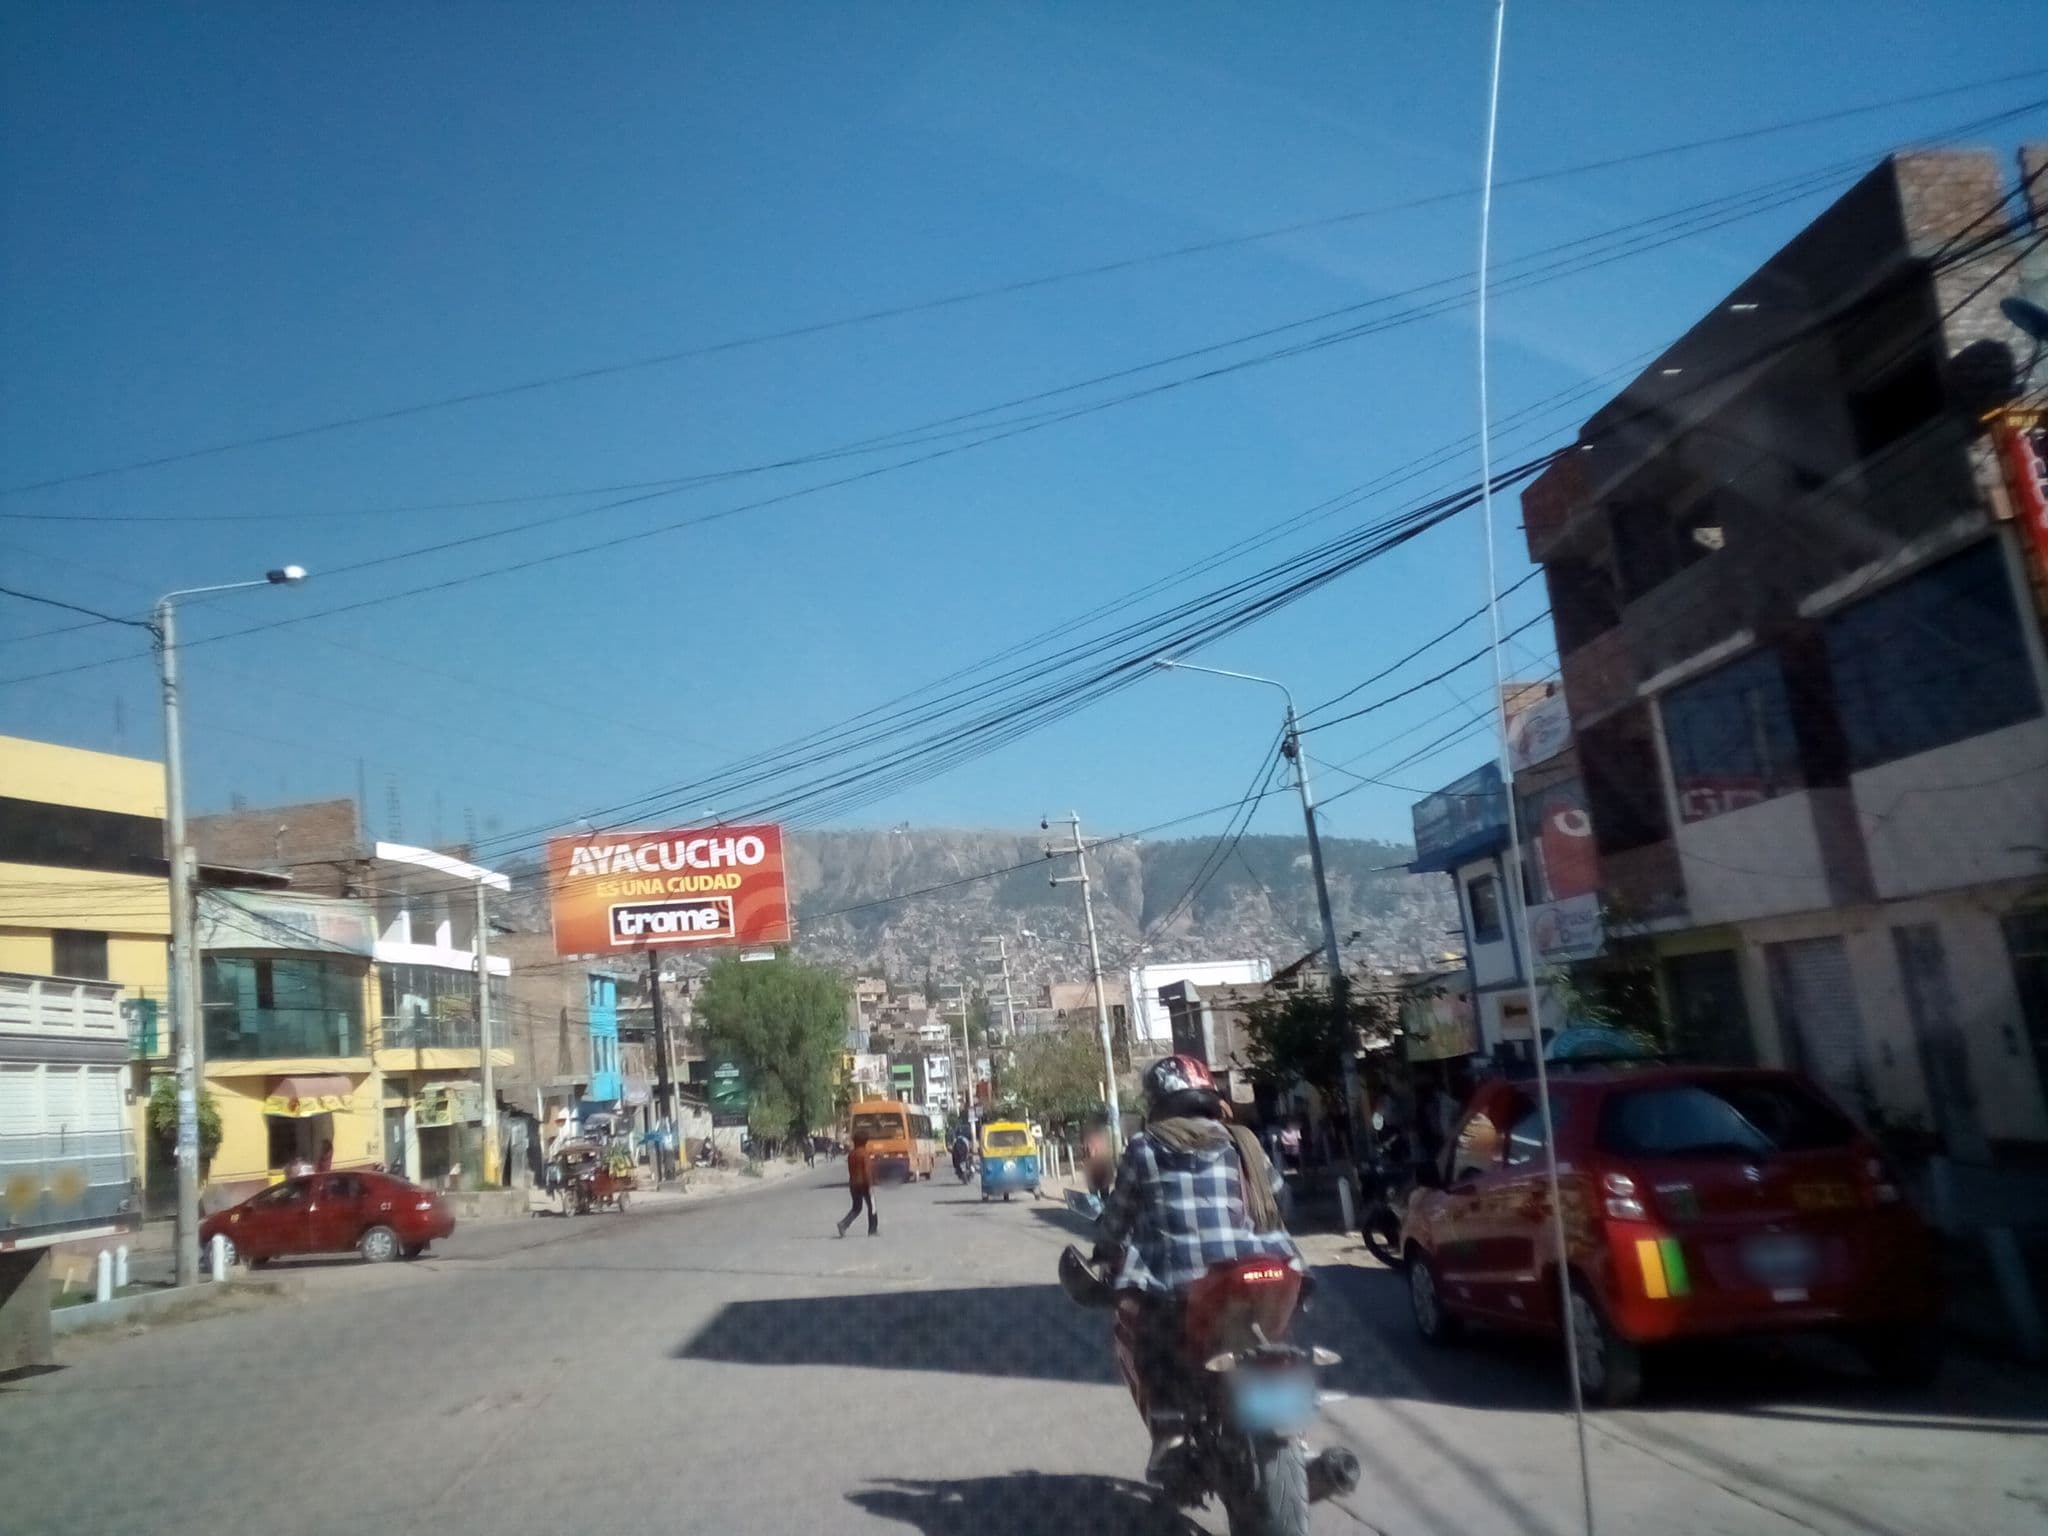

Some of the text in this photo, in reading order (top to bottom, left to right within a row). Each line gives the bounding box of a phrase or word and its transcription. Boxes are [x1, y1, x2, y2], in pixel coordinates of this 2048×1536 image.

[568, 835, 765, 877] AYACUCHO
[597, 873, 742, 898] ES UNA CIUDAD
[617, 906, 720, 936] trome
